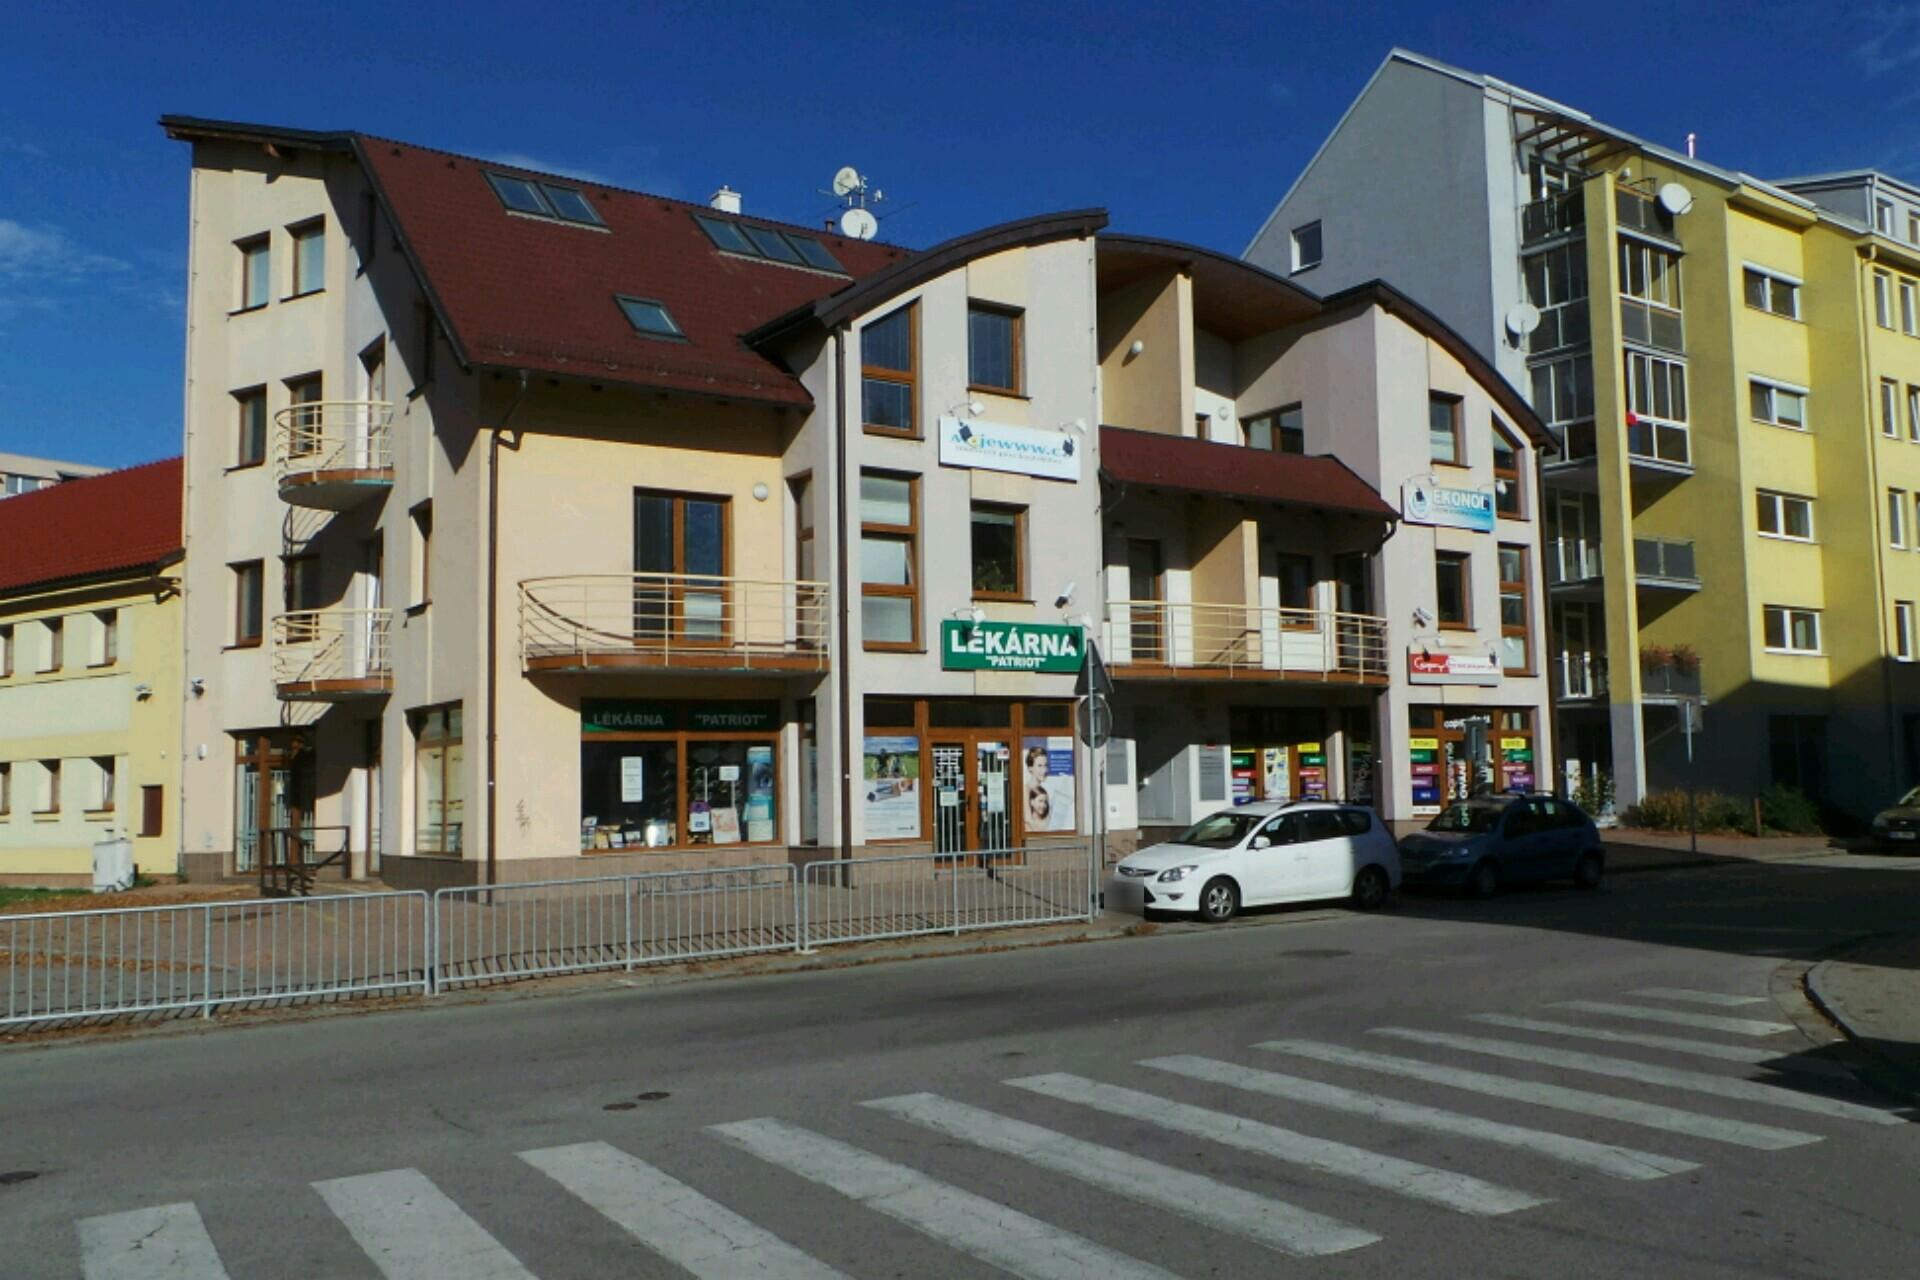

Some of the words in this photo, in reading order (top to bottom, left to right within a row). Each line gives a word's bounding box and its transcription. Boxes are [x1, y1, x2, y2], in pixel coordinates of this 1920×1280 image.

[952, 626, 1077, 657] LÉKÁRNA
[985, 655, 1046, 668] "PATRIOT"
[593, 711, 664, 726] LÉKÁRNA
[695, 713, 767, 726] "PATRIOT"
